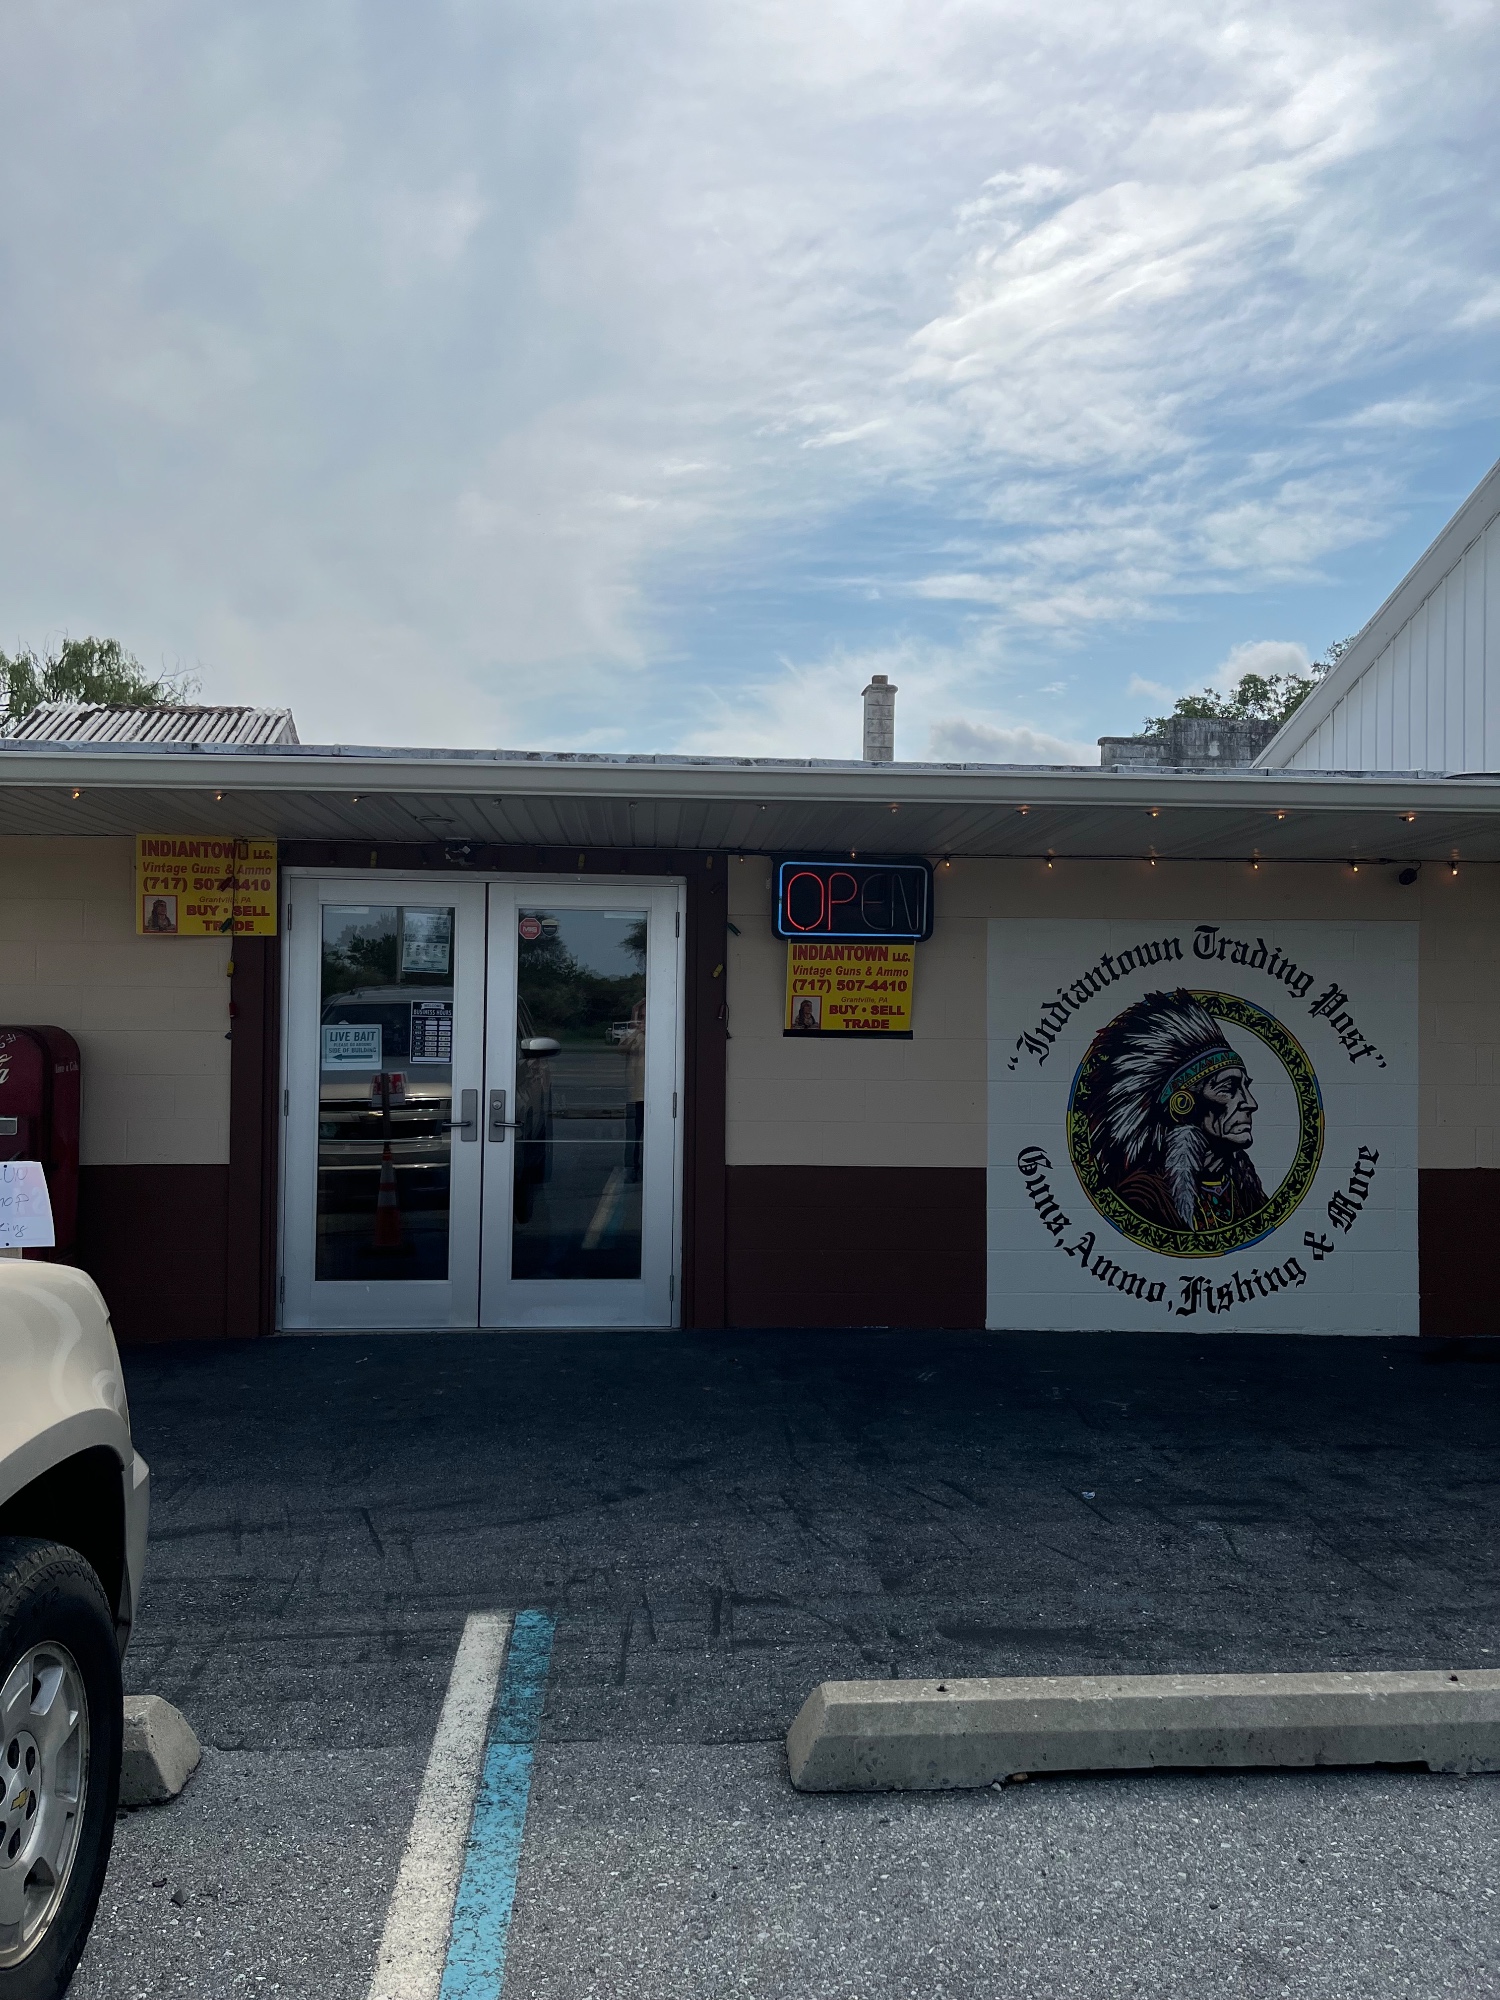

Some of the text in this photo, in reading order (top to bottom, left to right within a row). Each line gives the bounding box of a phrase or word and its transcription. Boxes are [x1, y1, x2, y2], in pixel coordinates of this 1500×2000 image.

[142, 861, 271, 876] Vintage Guns & Ammo
[143, 876, 188, 892] (717)
[787, 871, 920, 931] OPEN
[186, 904, 270, 916] BUY SELL
[792, 944, 888, 962] INDIANTOWN
[1193, 924, 1315, 998] Trading
[792, 964, 909, 978] Vintage Guns & Ammo
[792, 978, 908, 993] (717) 507-4410
[413, 1008, 436, 1016] BUSINESS
[829, 1004, 905, 1016] BUY SELL
[843, 1018, 890, 1030] TRADE
[330, 1031, 376, 1042] LIVE BAIT
[1175, 1257, 1307, 1316] Fishing
[1303, 1231, 1334, 1261] &
[1327, 1145, 1379, 1234] More
